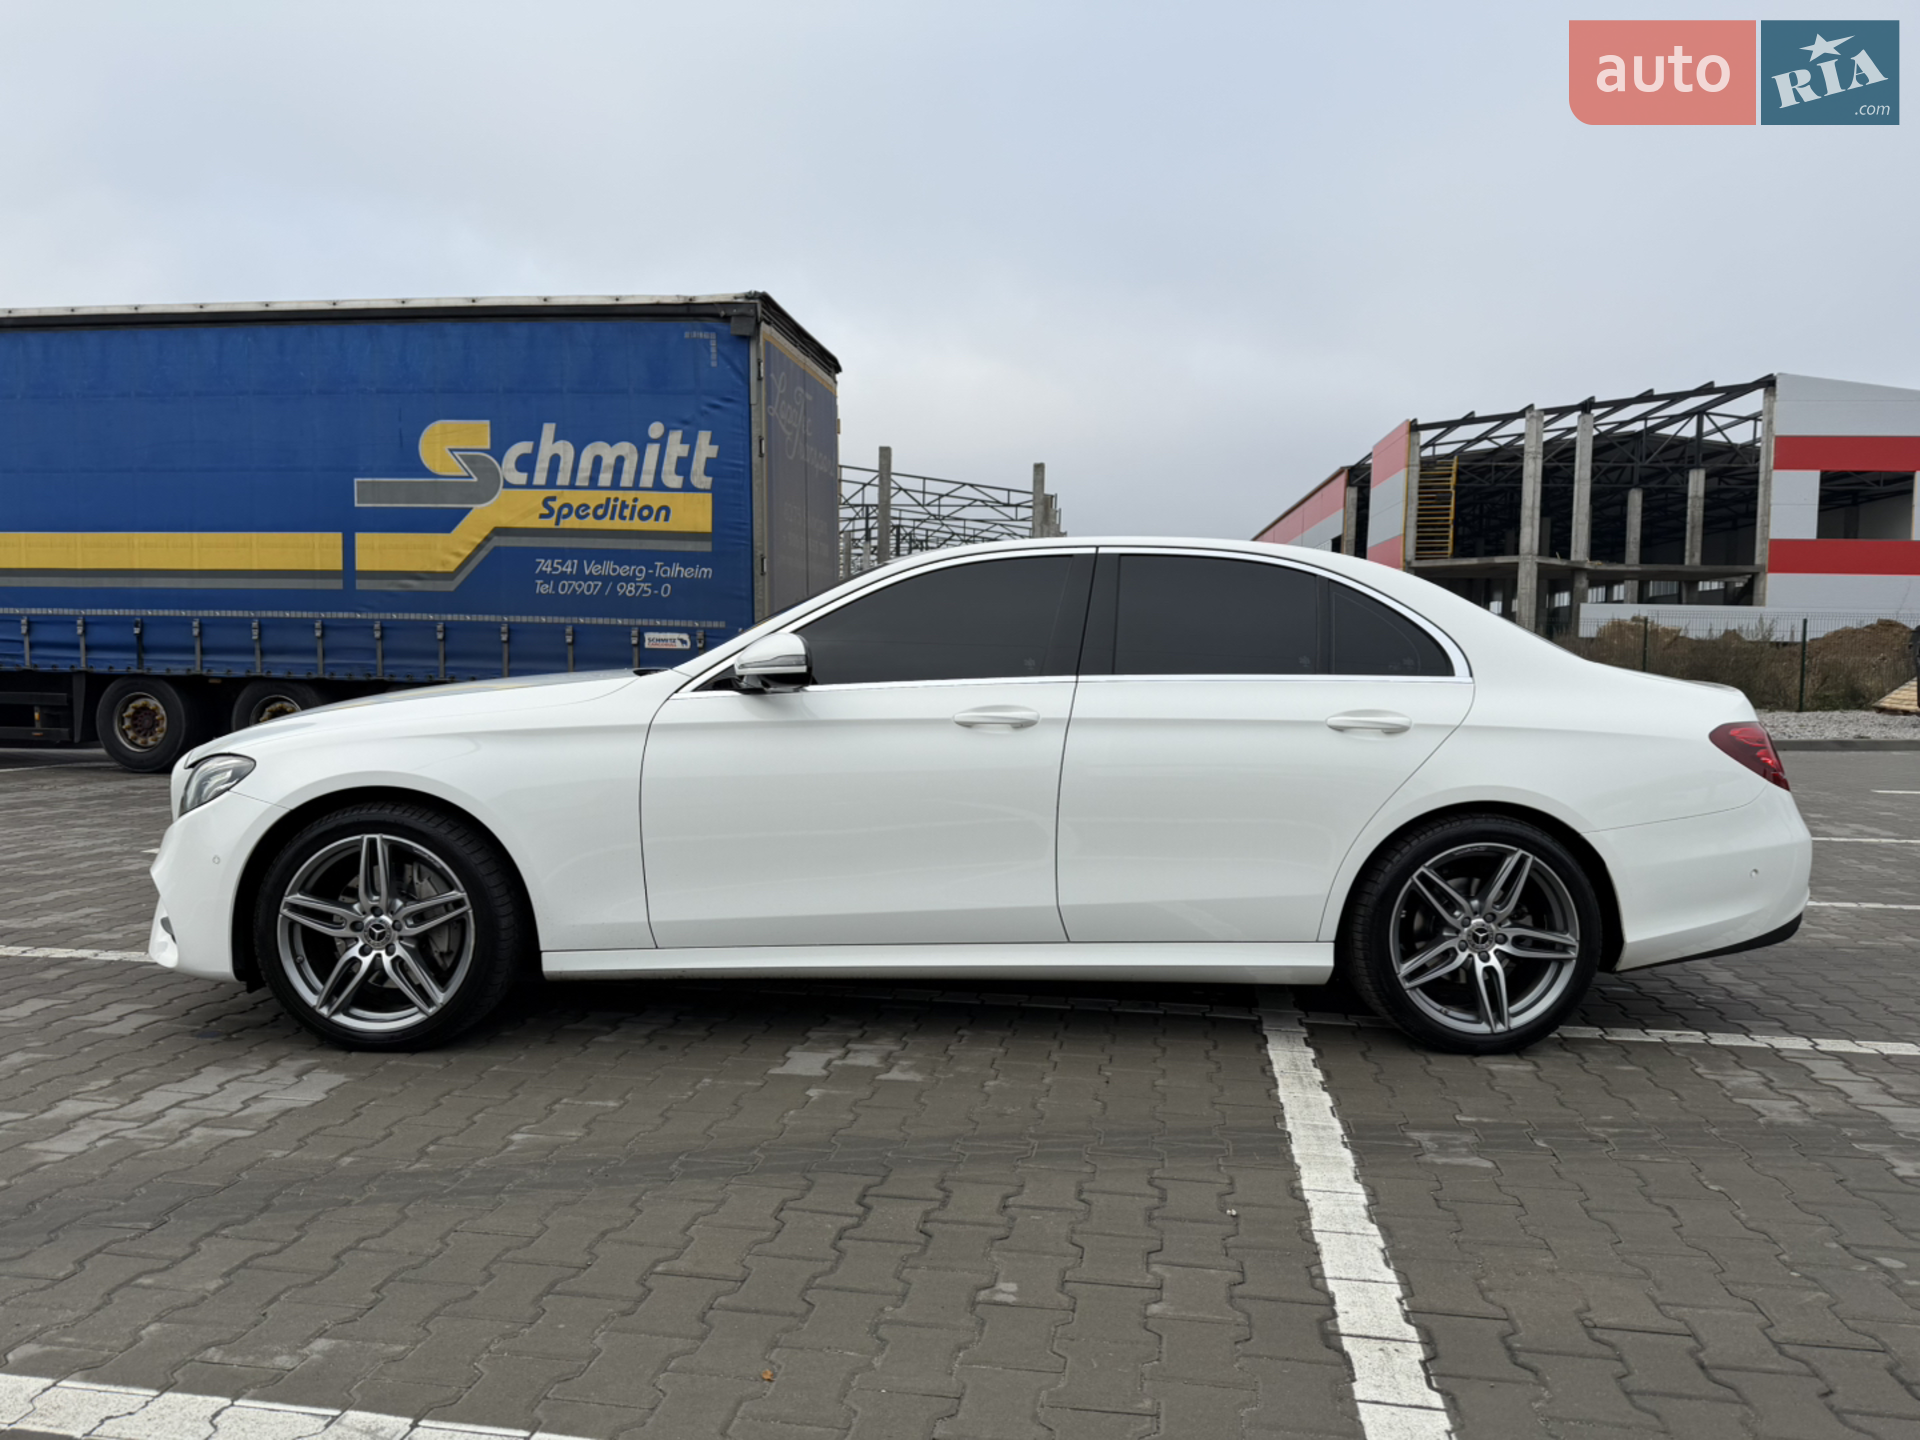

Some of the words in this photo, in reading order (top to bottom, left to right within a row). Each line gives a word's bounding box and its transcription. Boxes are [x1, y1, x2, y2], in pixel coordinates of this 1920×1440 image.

[418, 419, 720, 507] Schmitt
[538, 495, 672, 527] Spedition
[535, 558, 579, 575] 74541
[583, 559, 713, 581] Vellberg-Talheim
[535, 580, 555, 595] Tel.
[558, 581, 602, 595] 07907
